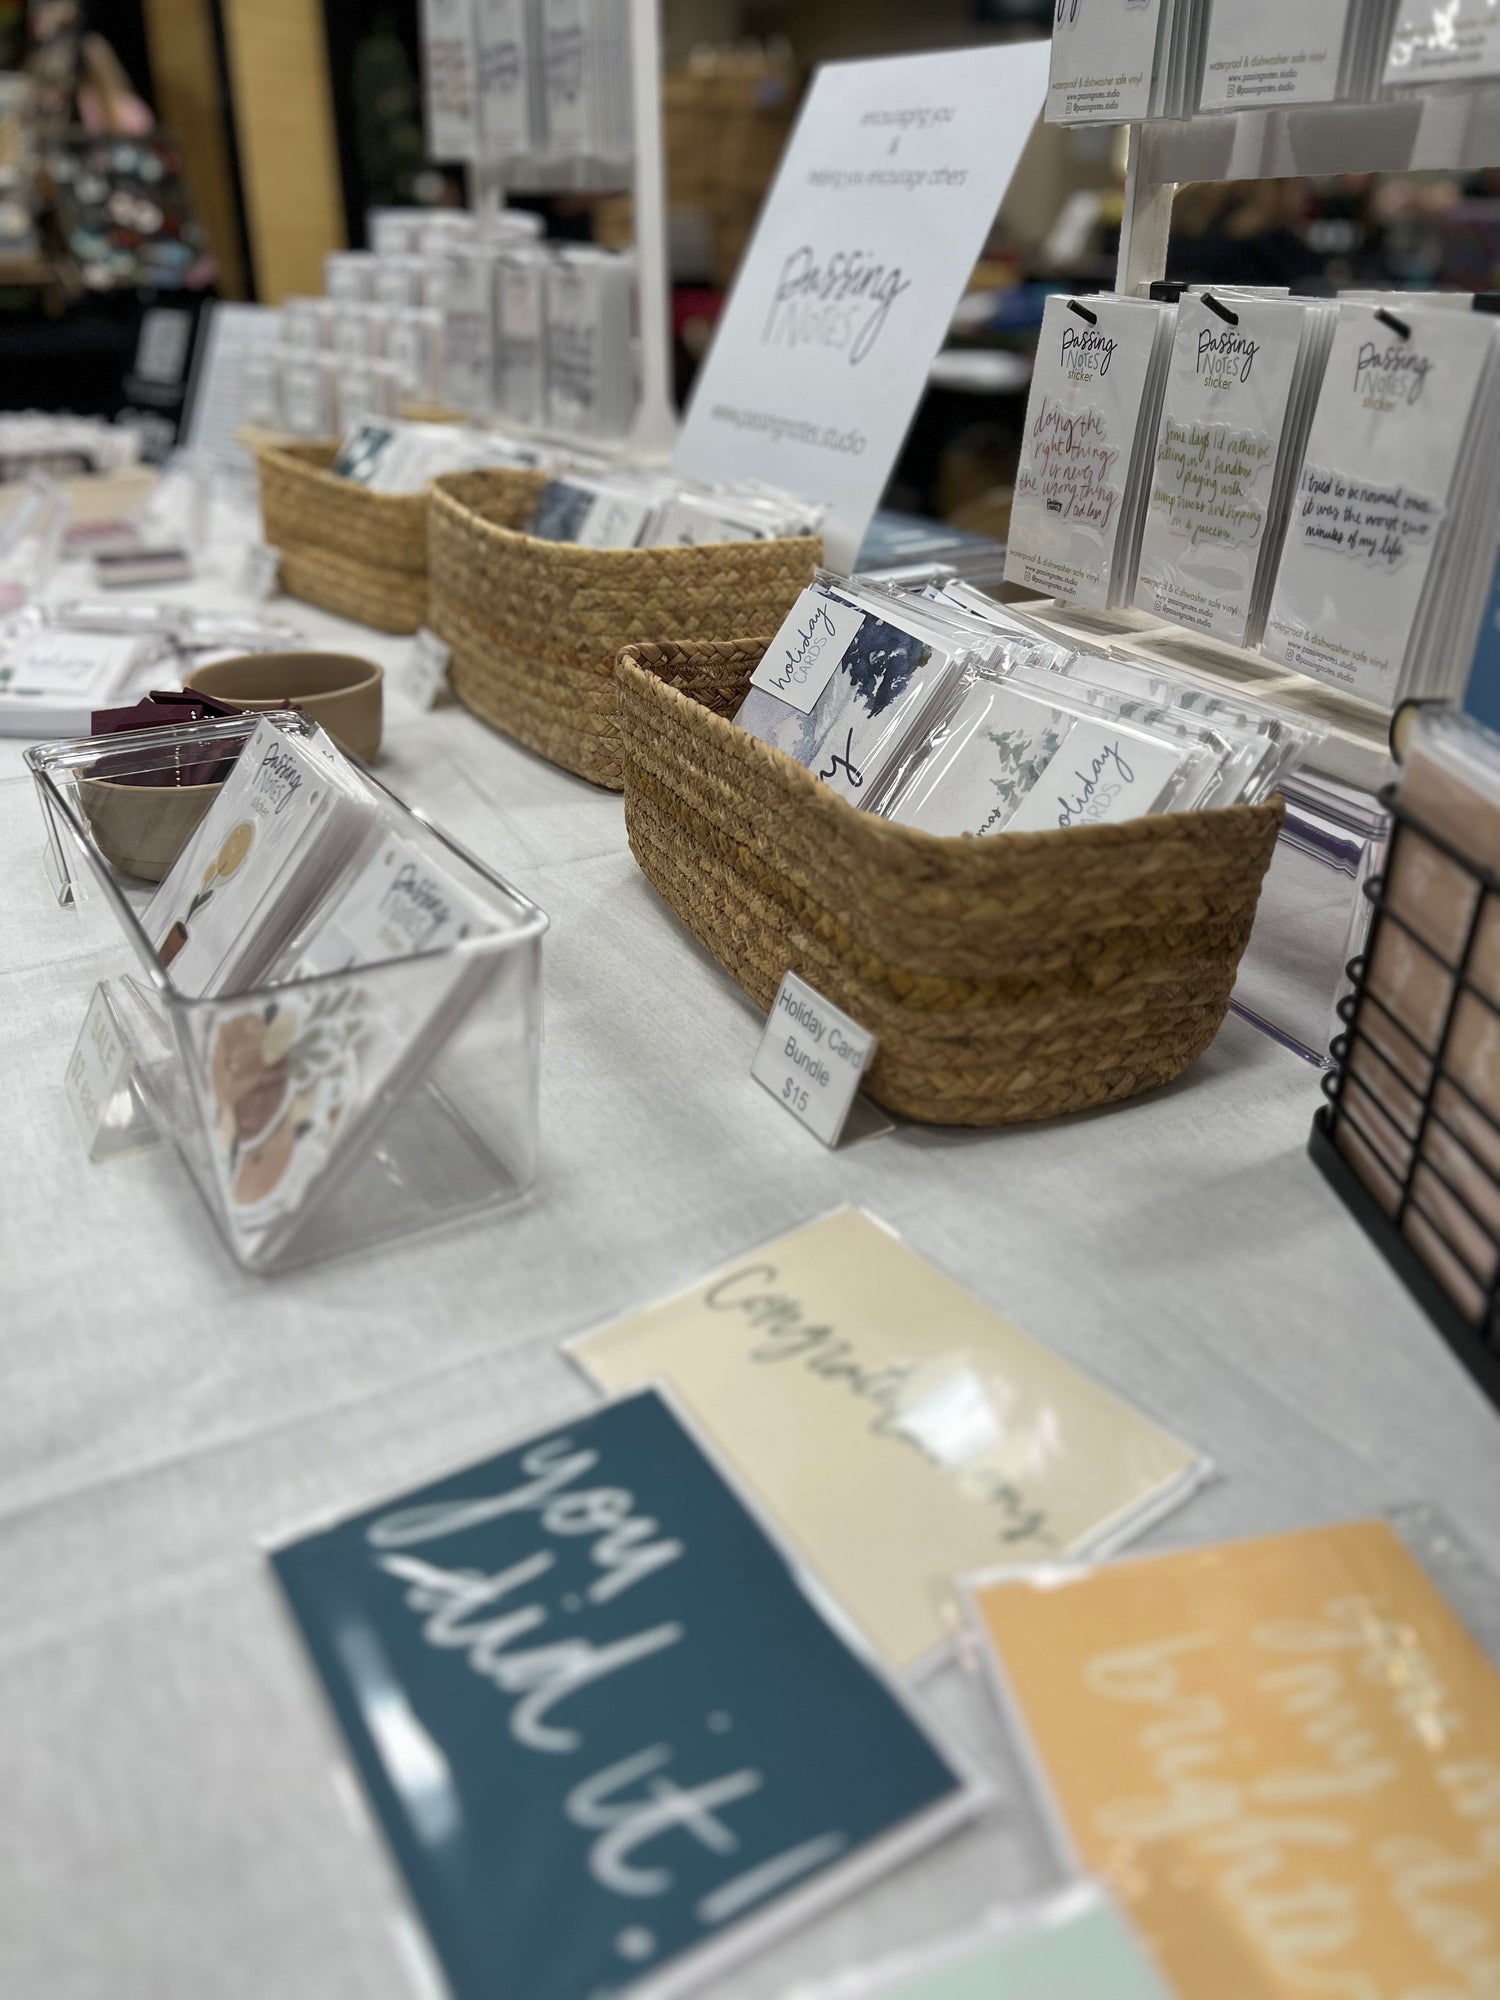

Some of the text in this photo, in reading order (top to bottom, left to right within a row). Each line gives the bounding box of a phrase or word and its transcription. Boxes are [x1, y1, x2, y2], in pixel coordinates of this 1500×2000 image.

[1209, 55, 1242, 71] waterproof
[1243, 56, 1249, 68] &
[1067, 368, 1093, 382] sticker
[1204, 375, 1232, 390] sticker
[1034, 397, 1102, 453] doing the
[1035, 436, 1064, 477] right
[1020, 473, 1118, 528] the wrong thing
[1221, 480, 1244, 496] with
[1301, 469, 1308, 490] I
[1308, 473, 1333, 494] tried
[1335, 481, 1346, 497] to
[1347, 485, 1359, 499] be
[1302, 496, 1430, 536] it was the worst two
[1305, 524, 1344, 544] minutes
[1347, 529, 1359, 549] of
[1359, 539, 1377, 557] my
[1010, 549, 1037, 563] waterproof
[1042, 558, 1072, 574] dishwasher
[1073, 568, 1085, 578] safe
[1086, 573, 1100, 584] vinyl
[1168, 584, 1174, 593] &
[1208, 598, 1221, 609] safe
[1222, 604, 1238, 616] vinyl
[769, 603, 836, 691] holiday
[792, 636, 828, 685] CARDS
[1269, 621, 1389, 673] waterproof & dishwasher safe vinyl
[1287, 640, 1357, 672] www.passingnotes.studio
[1295, 653, 1354, 683] @passingnotes.studio
[1057, 741, 1134, 829] oliday
[1080, 783, 1122, 826] ARDS
[778, 988, 864, 1069] Holiday Card
[784, 1035, 830, 1087] Bundle
[782, 1076, 810, 1112] $15
[366, 1434, 686, 1606] you
[370, 1549, 686, 1755] did
